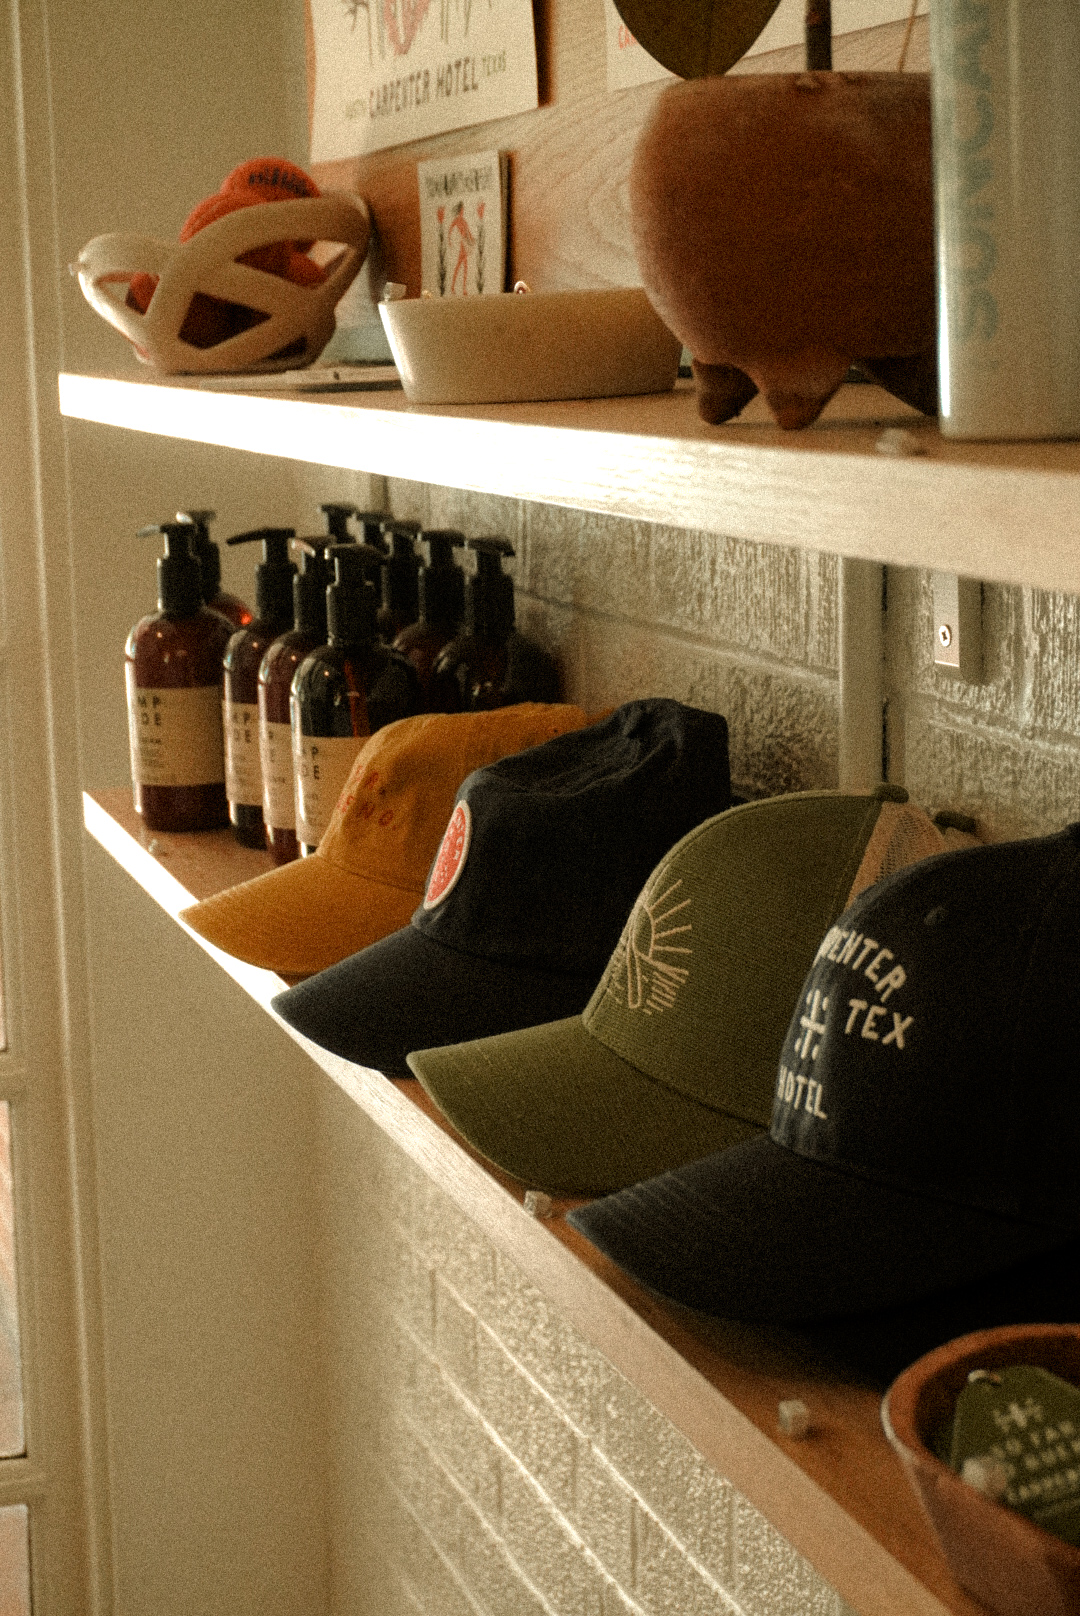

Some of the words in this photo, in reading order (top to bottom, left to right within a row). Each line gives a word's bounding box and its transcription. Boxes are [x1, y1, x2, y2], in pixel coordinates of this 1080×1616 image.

[435, 56, 478, 99] HOTEL
[845, 998, 915, 1050] TEX
[776, 1065, 828, 1120] HOTEL
